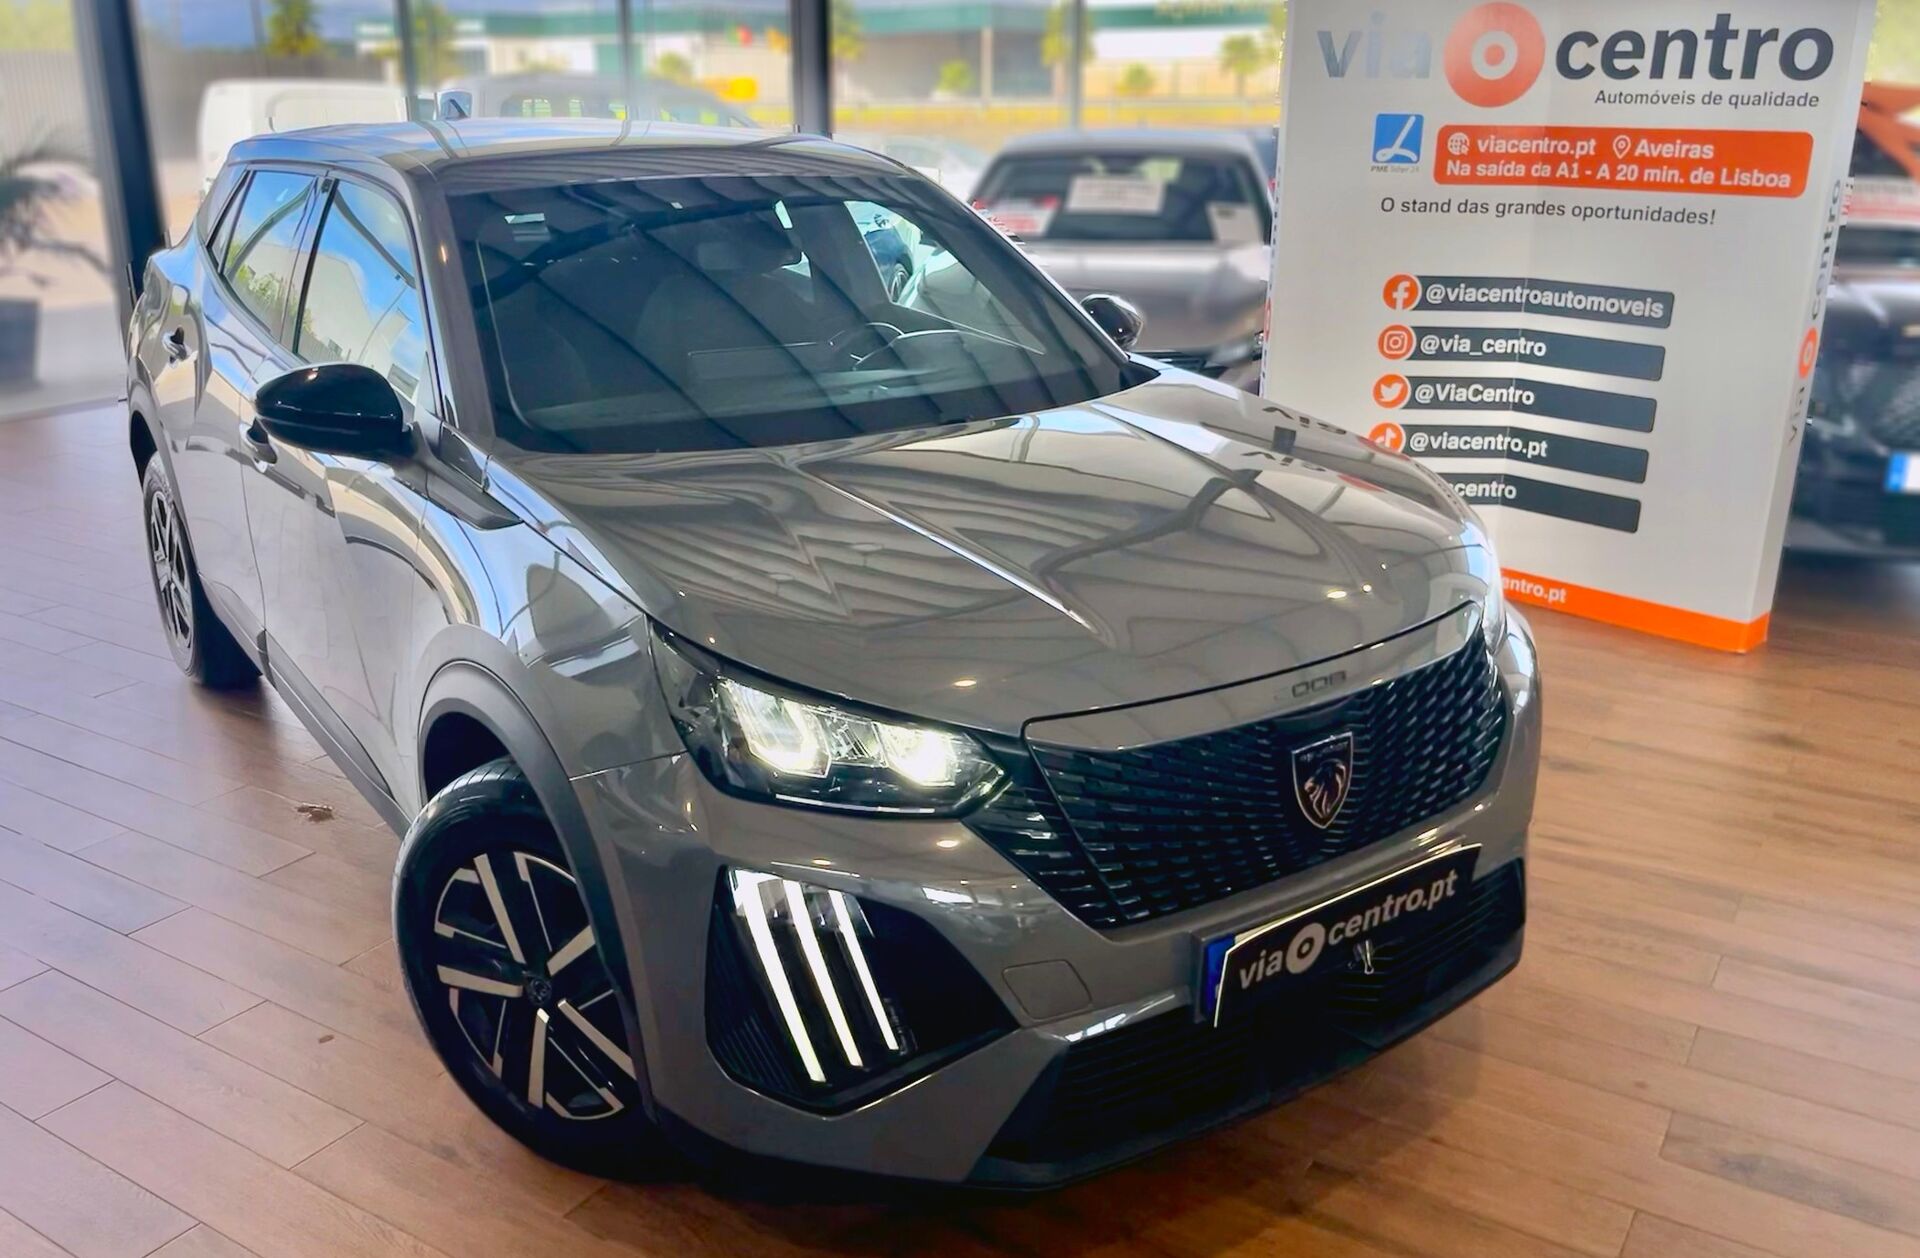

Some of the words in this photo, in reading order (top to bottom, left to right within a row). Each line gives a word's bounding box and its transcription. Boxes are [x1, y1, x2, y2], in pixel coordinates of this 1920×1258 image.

[1317, 10, 1432, 79] via
[1556, 13, 1834, 80] centro
[1595, 90, 1695, 105] Automóveis
[1702, 91, 1722, 106] de
[1728, 91, 1820, 109] qualidade
[1477, 135, 1596, 158] viacentro.pt
[1634, 139, 1715, 159] Aveiras
[1447, 160, 1470, 176] Na
[1476, 160, 1526, 177] saída
[1531, 162, 1551, 176] da
[1555, 163, 1579, 179] A1
[1596, 164, 1610, 180] A
[1616, 164, 1639, 181] 20
[1643, 166, 1685, 184] min.
[1690, 168, 1715, 185] de
[1720, 169, 1792, 188] Lisboa
[1380, 197, 1395, 213] O
[1401, 199, 1451, 213] stand
[1457, 199, 1489, 214] das
[1495, 200, 1566, 217] grandes
[1571, 203, 1716, 225] oportunidades!
[1426, 283, 1664, 318] @viacentroautomoveis
[1420, 334, 1547, 357] @via_centro
[1415, 383, 1535, 406] @ViaCentro
[1410, 431, 1548, 459] @viacentro.pt
[1449, 480, 1518, 500] centro
[1239, 948, 1283, 989] via
[1328, 868, 1459, 946] centro.pt
